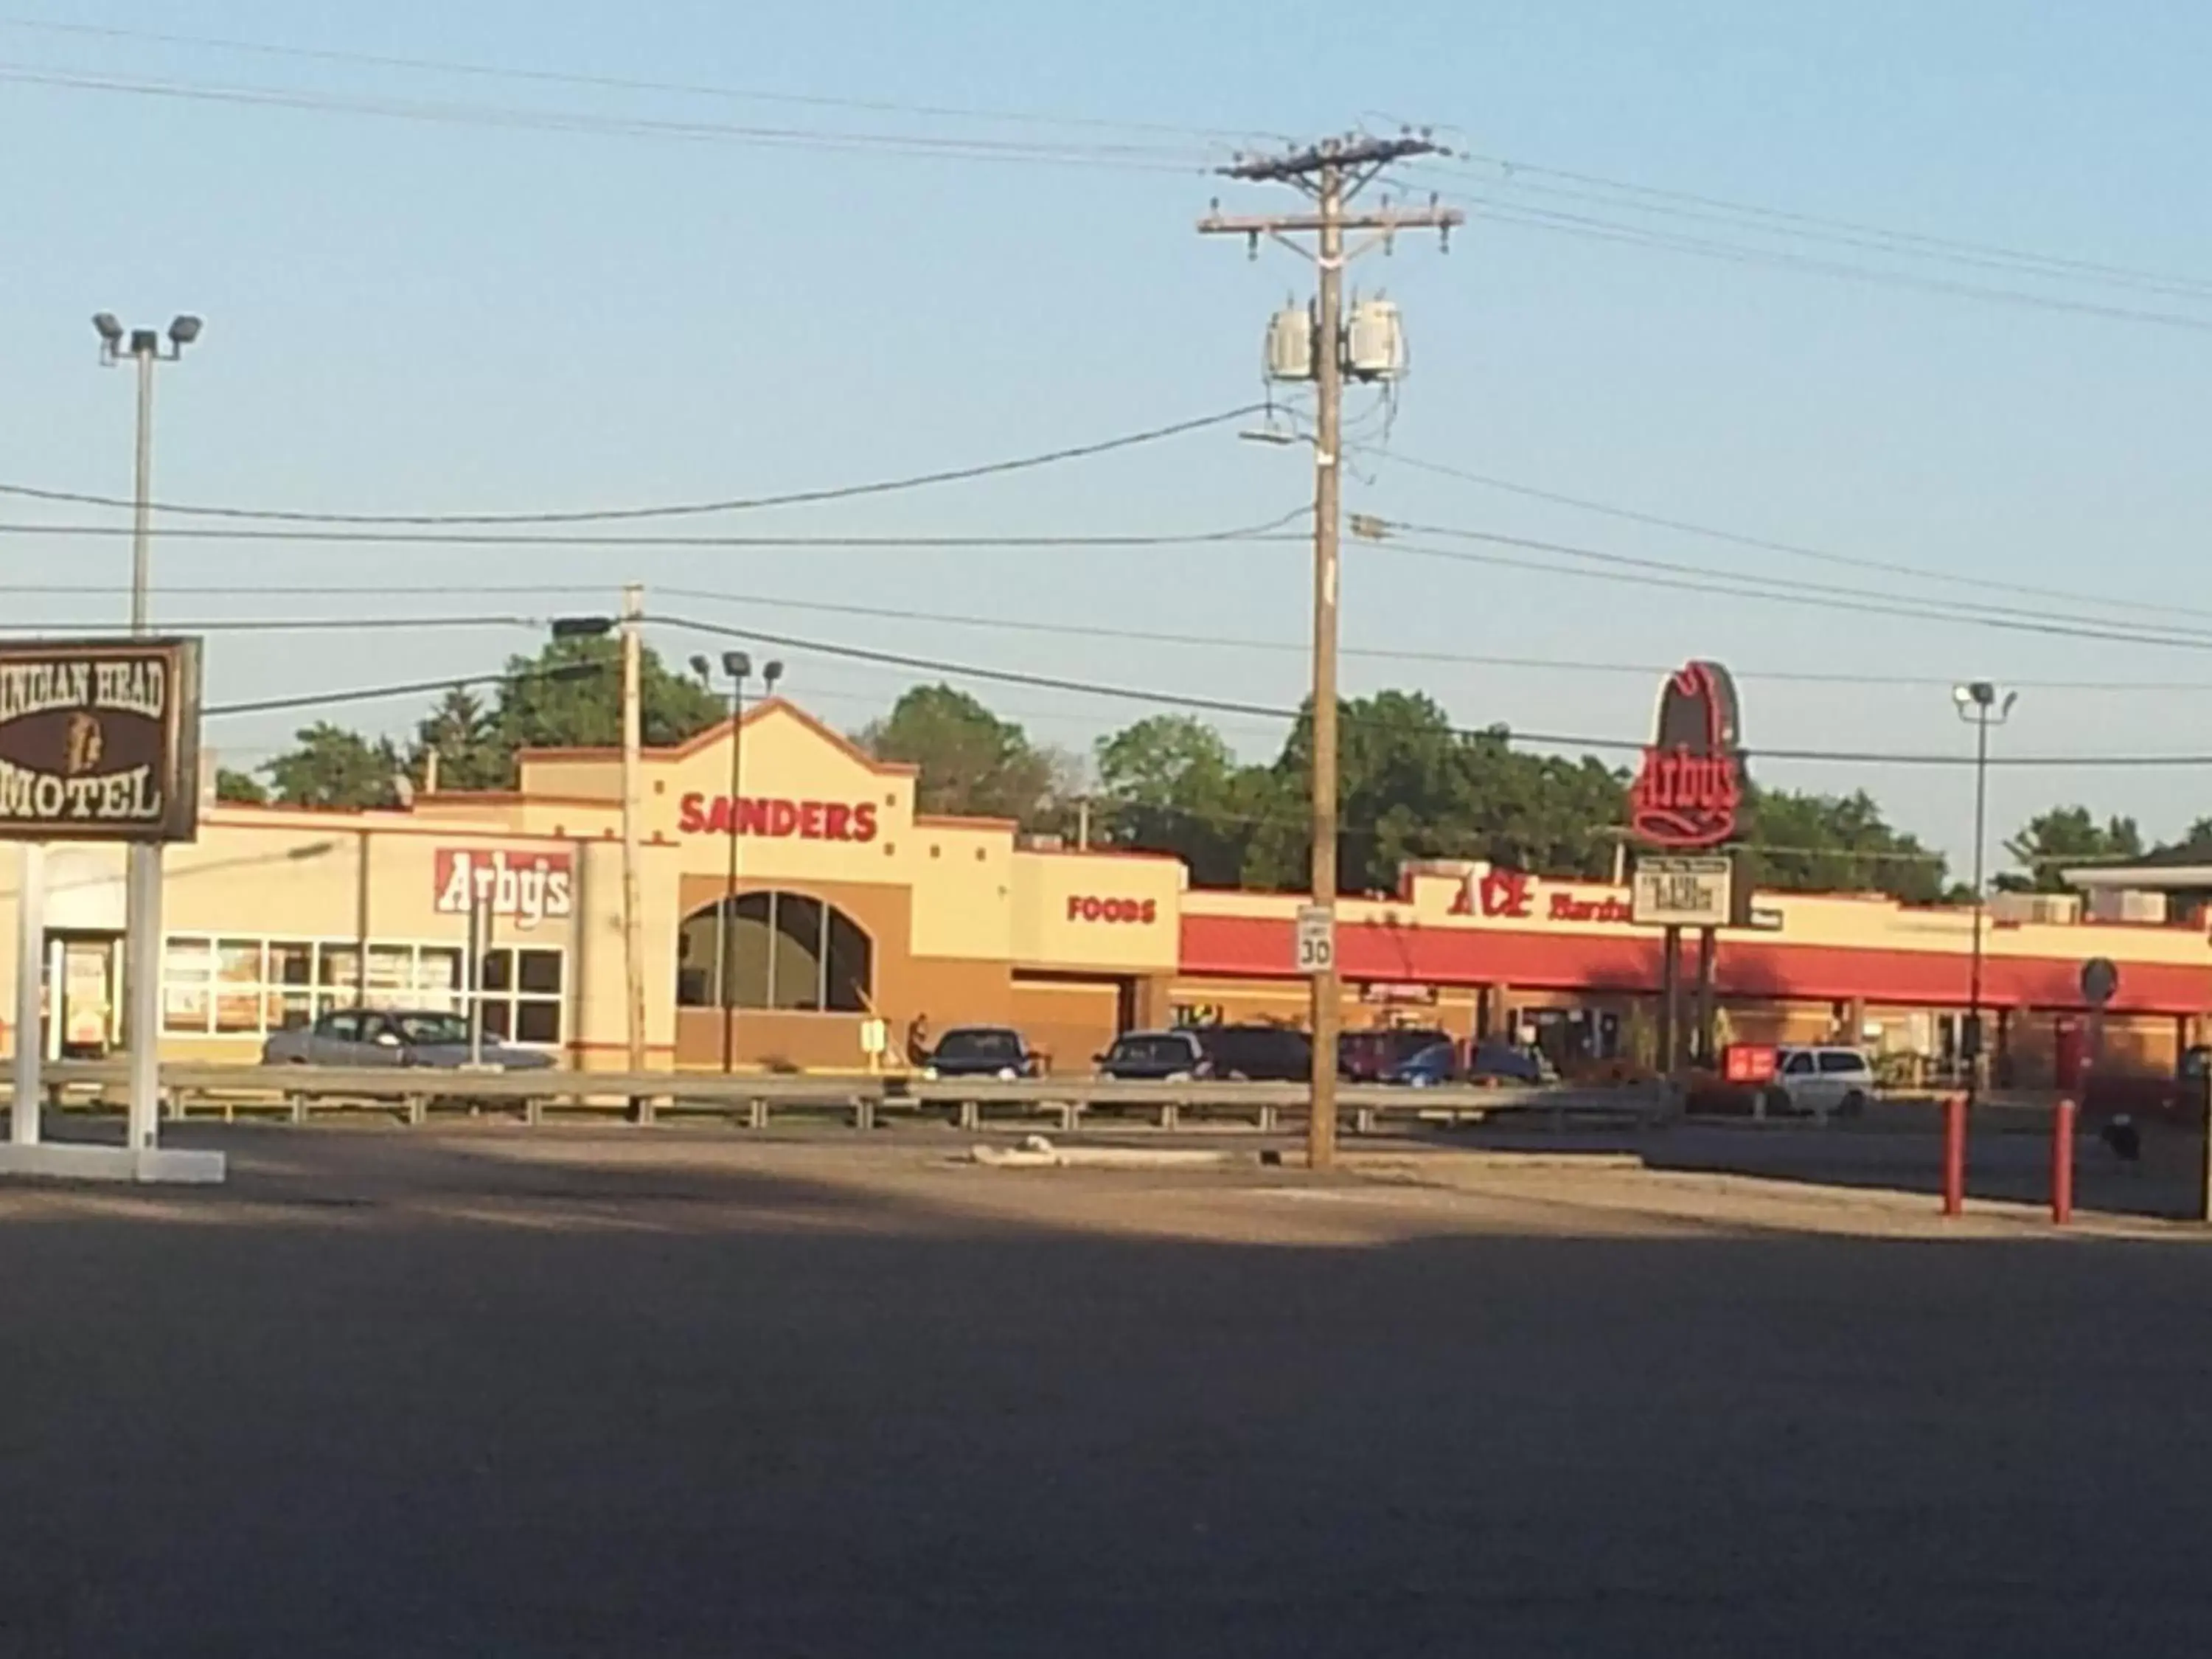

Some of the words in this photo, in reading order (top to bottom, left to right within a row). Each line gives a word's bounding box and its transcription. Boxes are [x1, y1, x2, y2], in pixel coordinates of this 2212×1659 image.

[94, 661, 163, 719] HEAD
[0, 759, 161, 818] MOTEL
[678, 792, 877, 843] SANDERS
[439, 851, 569, 929] Arby's
[1067, 895, 1156, 925] FOODS
[1302, 939, 1329, 964] 30
